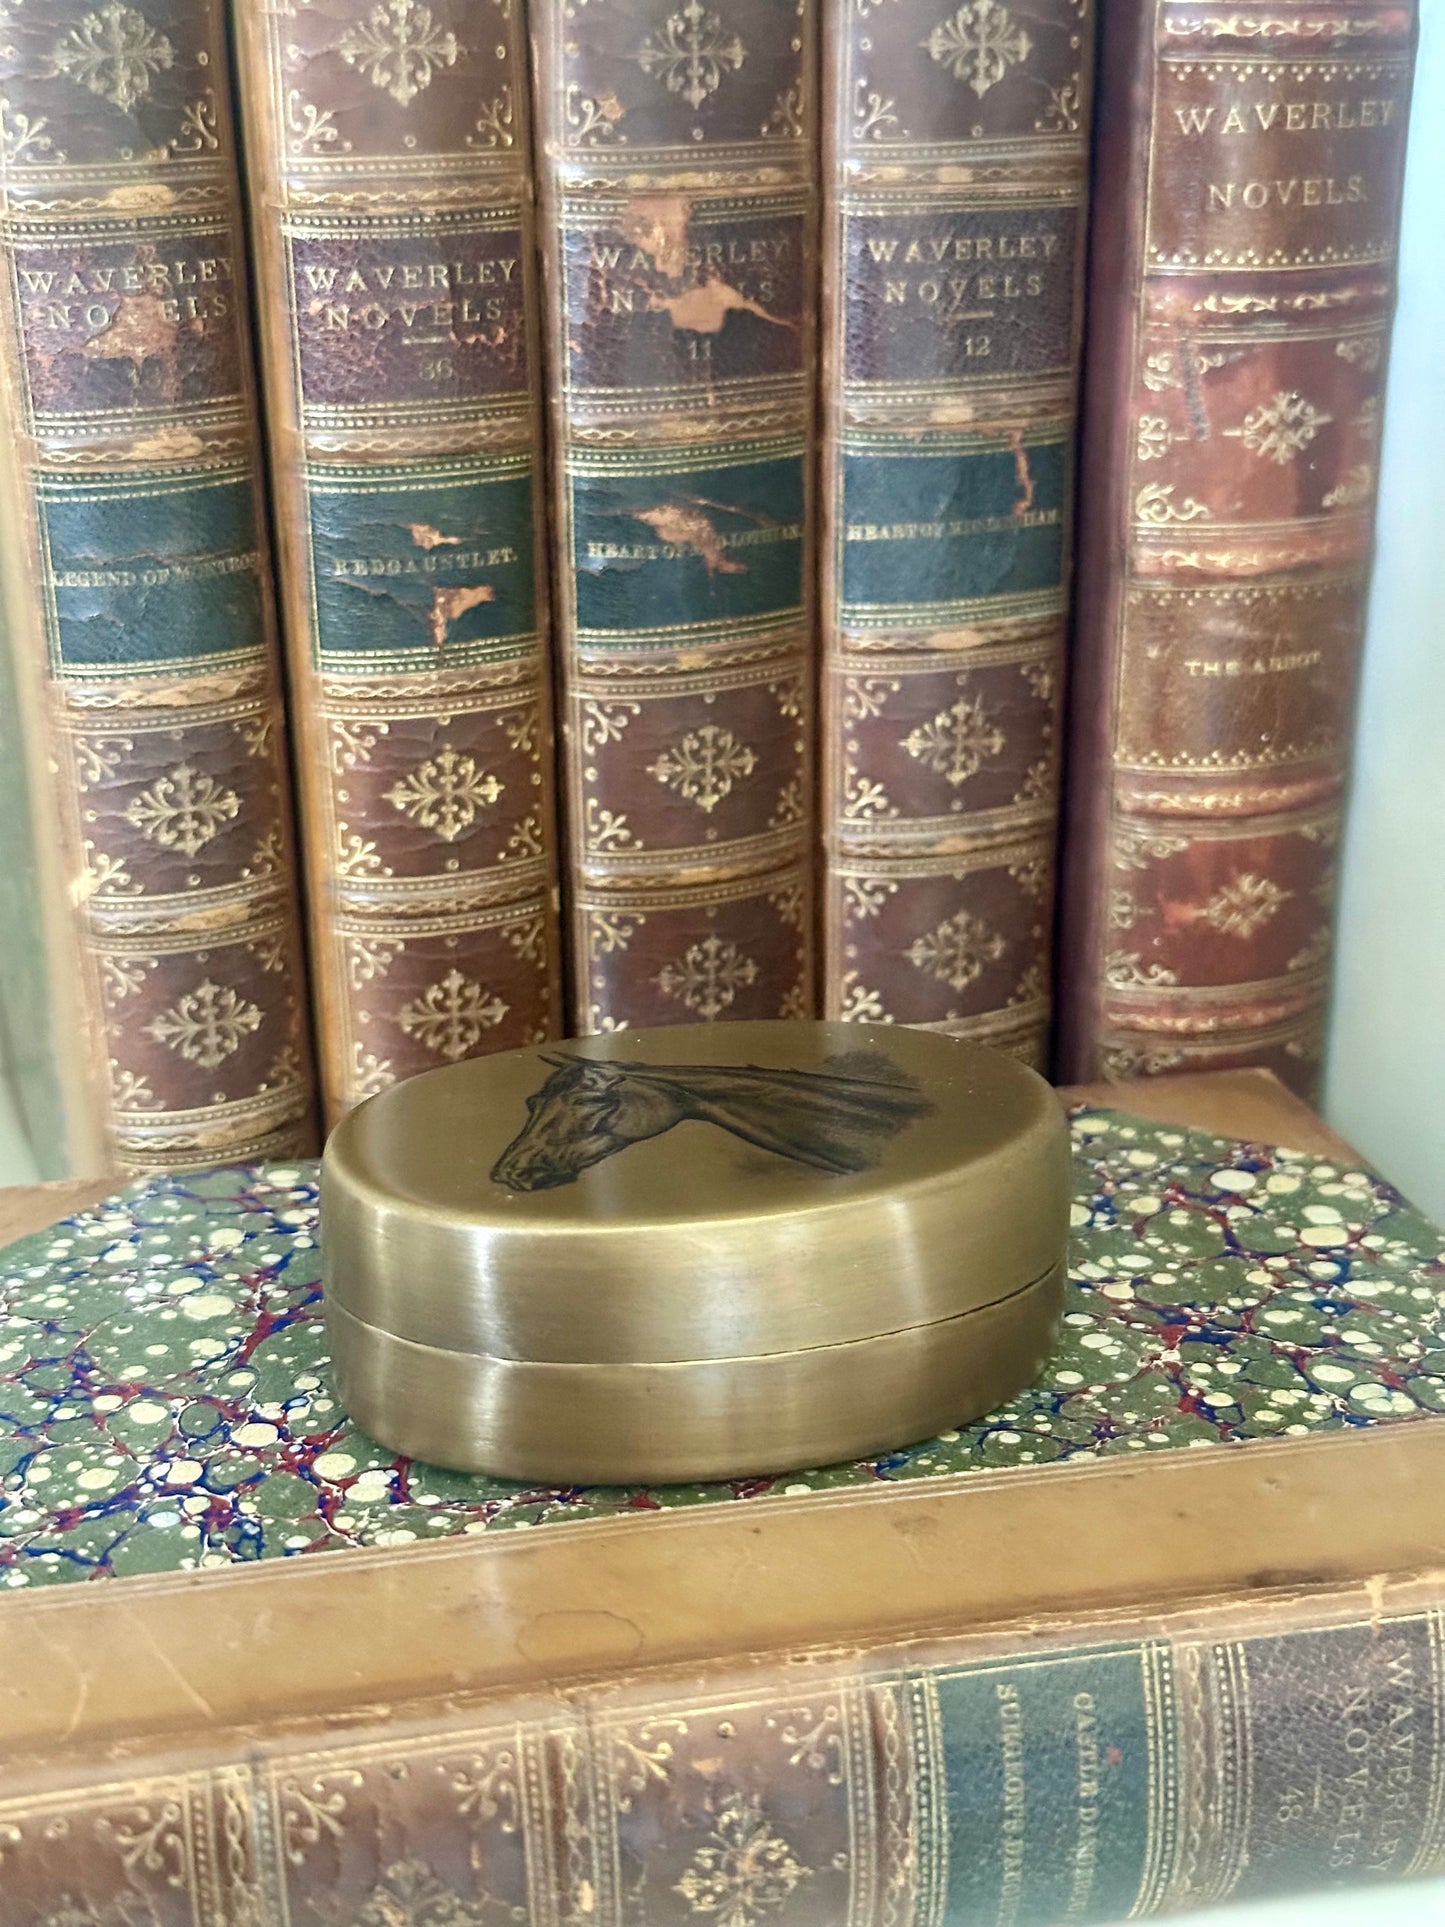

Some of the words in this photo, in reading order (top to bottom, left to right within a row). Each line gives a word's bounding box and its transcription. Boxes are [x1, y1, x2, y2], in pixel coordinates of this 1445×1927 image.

[1174, 101, 1393, 135] WAVERLEY
[594, 237, 789, 269] WAERLEY
[868, 235, 1057, 263] WAVERLEY
[20, 257, 233, 294] WAVERLEY
[304, 259, 516, 291] WAVERLEY
[885, 275, 1041, 304] NOVELS
[49, 296, 228, 329] NOELS
[327, 298, 502, 331] NOVELS
[965, 335, 991, 356] 12
[847, 522, 917, 541] HEART
[587, 541, 658, 560] HEART
[53, 570, 137, 587] LEGEND
[143, 568, 170, 586] OF
[1184, 658, 1240, 676] THE
[1329, 1686, 1372, 1868] NOVELS
[1367, 1652, 1416, 1871] WAVERLEY
[1278, 1786, 1304, 1822] 48
